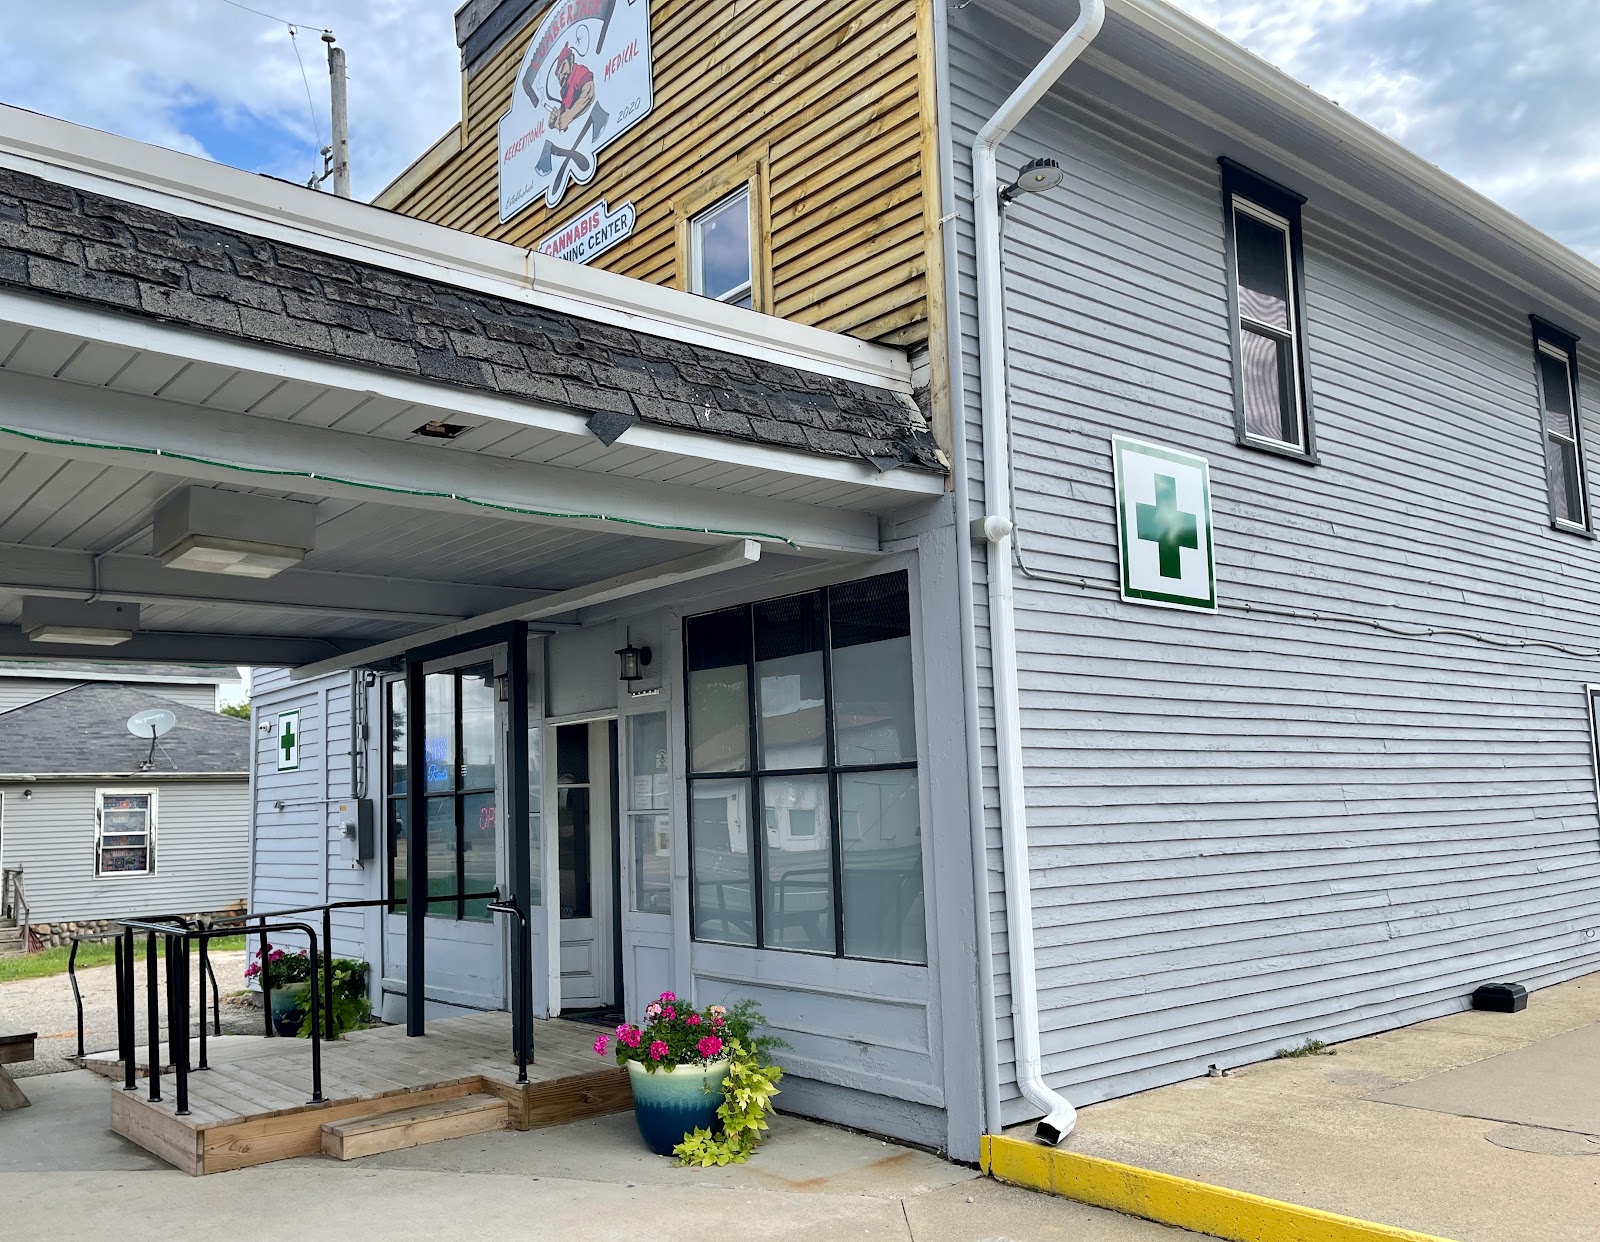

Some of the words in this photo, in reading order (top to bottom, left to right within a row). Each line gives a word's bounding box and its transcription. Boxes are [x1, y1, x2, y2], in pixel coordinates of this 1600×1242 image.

[603, 38, 639, 82] MEDICAL
[616, 97, 641, 124] 2020
[544, 211, 600, 257] CANNABIS
[559, 242, 585, 262] NING
[588, 213, 627, 249] CENTER
